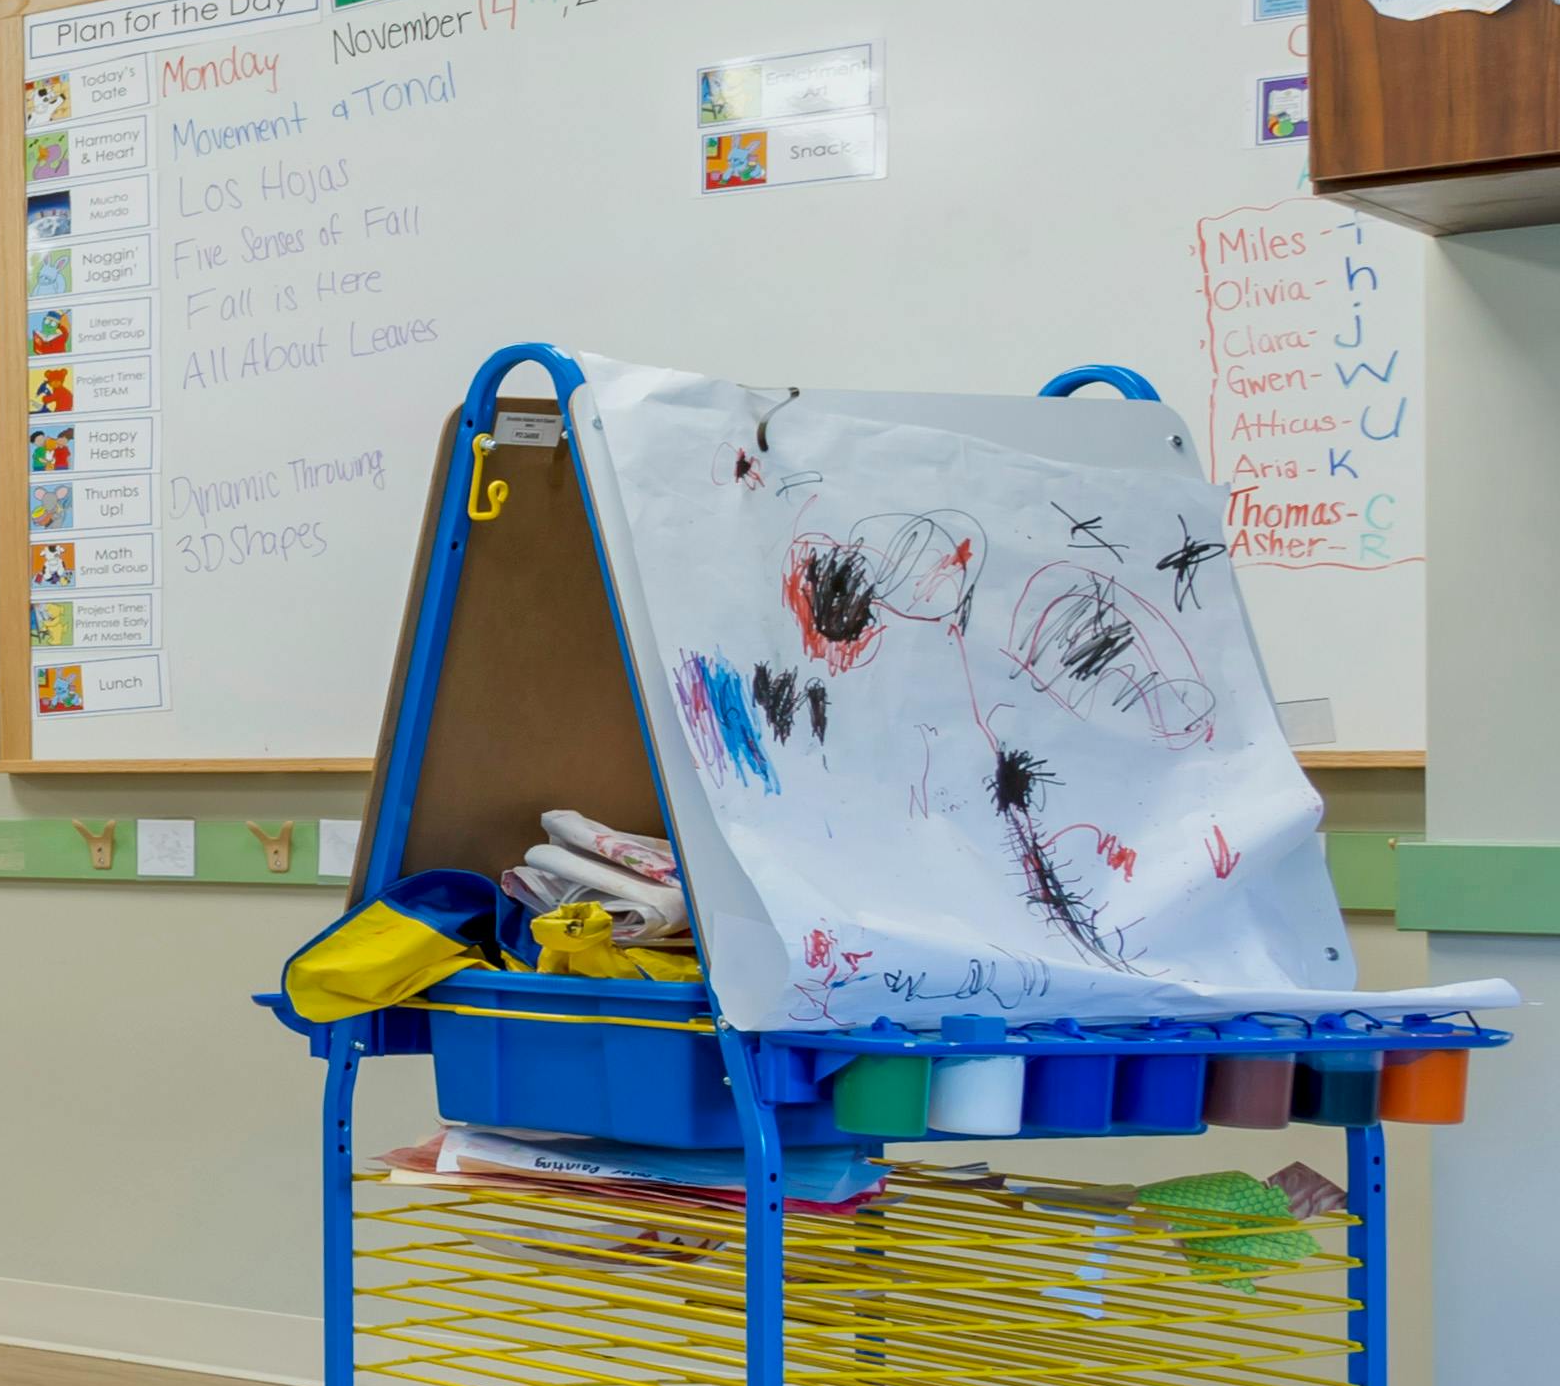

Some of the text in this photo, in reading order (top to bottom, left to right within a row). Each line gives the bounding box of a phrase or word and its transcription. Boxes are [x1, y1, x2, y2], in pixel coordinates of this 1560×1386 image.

[55, 20, 115, 47] Plan
[123, 10, 161, 36] for
[171, 1, 220, 26] the
[333, 10, 473, 64] November
[80, 65, 136, 88] Today's
[162, 45, 280, 97] Monday
[91, 86, 128, 103] Date
[172, 61, 456, 161] Movement Tonal
[74, 128, 141, 149] Harmony
[81, 145, 135, 164] & Heart
[789, 140, 854, 160] Snack
[178, 159, 350, 218] Los Hojas
[89, 192, 129, 207] Mucho
[89, 206, 129, 221] Mundo
[174, 206, 420, 279] Five Senses of Fall
[1219, 226, 1307, 264] Miles
[82, 245, 139, 267] Noggin'
[84, 264, 138, 283] Joggin'
[186, 269, 383, 329] Fall is Here
[89, 315, 135, 330] Literacy
[78, 327, 145, 344] Small Group
[183, 318, 440, 389] All About Leaves
[76, 373, 115, 386] Project
[93, 387, 129, 398] STEAM
[89, 430, 138, 446] Happy
[90, 446, 136, 460] Hearts
[85, 485, 140, 501] Thumbs
[168, 449, 386, 528] Dynamic Throwing
[100, 501, 124, 518] Up!
[95, 547, 133, 562] Math
[80, 562, 149, 576] Small Group
[77, 604, 116, 616] Project
[75, 616, 149, 630] Primrose Early
[82, 631, 142, 642] Art Masters
[98, 676, 143, 692] Lunch
